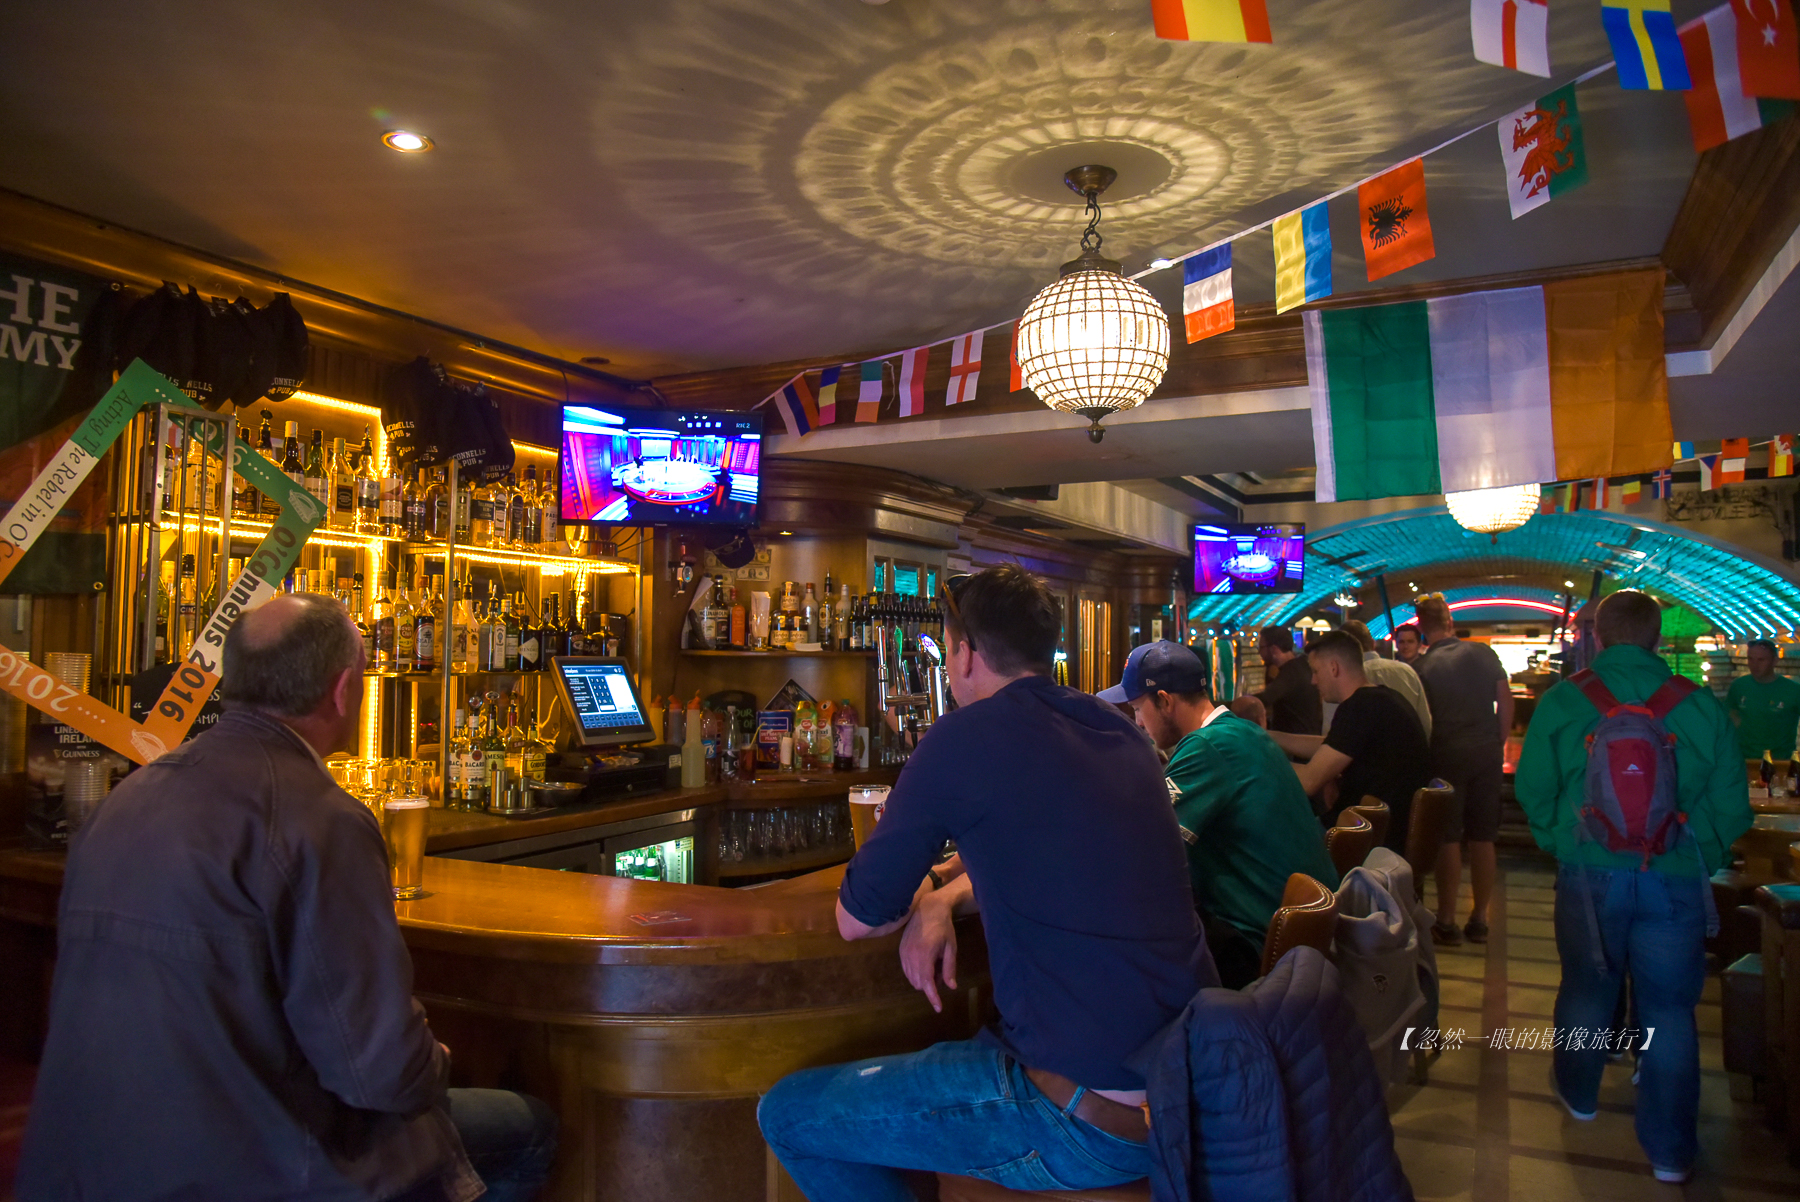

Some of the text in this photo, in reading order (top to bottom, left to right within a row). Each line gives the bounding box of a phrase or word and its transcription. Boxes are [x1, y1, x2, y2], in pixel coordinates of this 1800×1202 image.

[0, 323, 82, 371] MY
[88, 389, 133, 437] Acting
[69, 432, 100, 466] The
[462, 458, 477, 467] PUB
[36, 462, 77, 510] Rebel
[21, 502, 46, 523] in
[158, 649, 217, 723] 2016
[62, 750, 100, 758] GUINNESS
